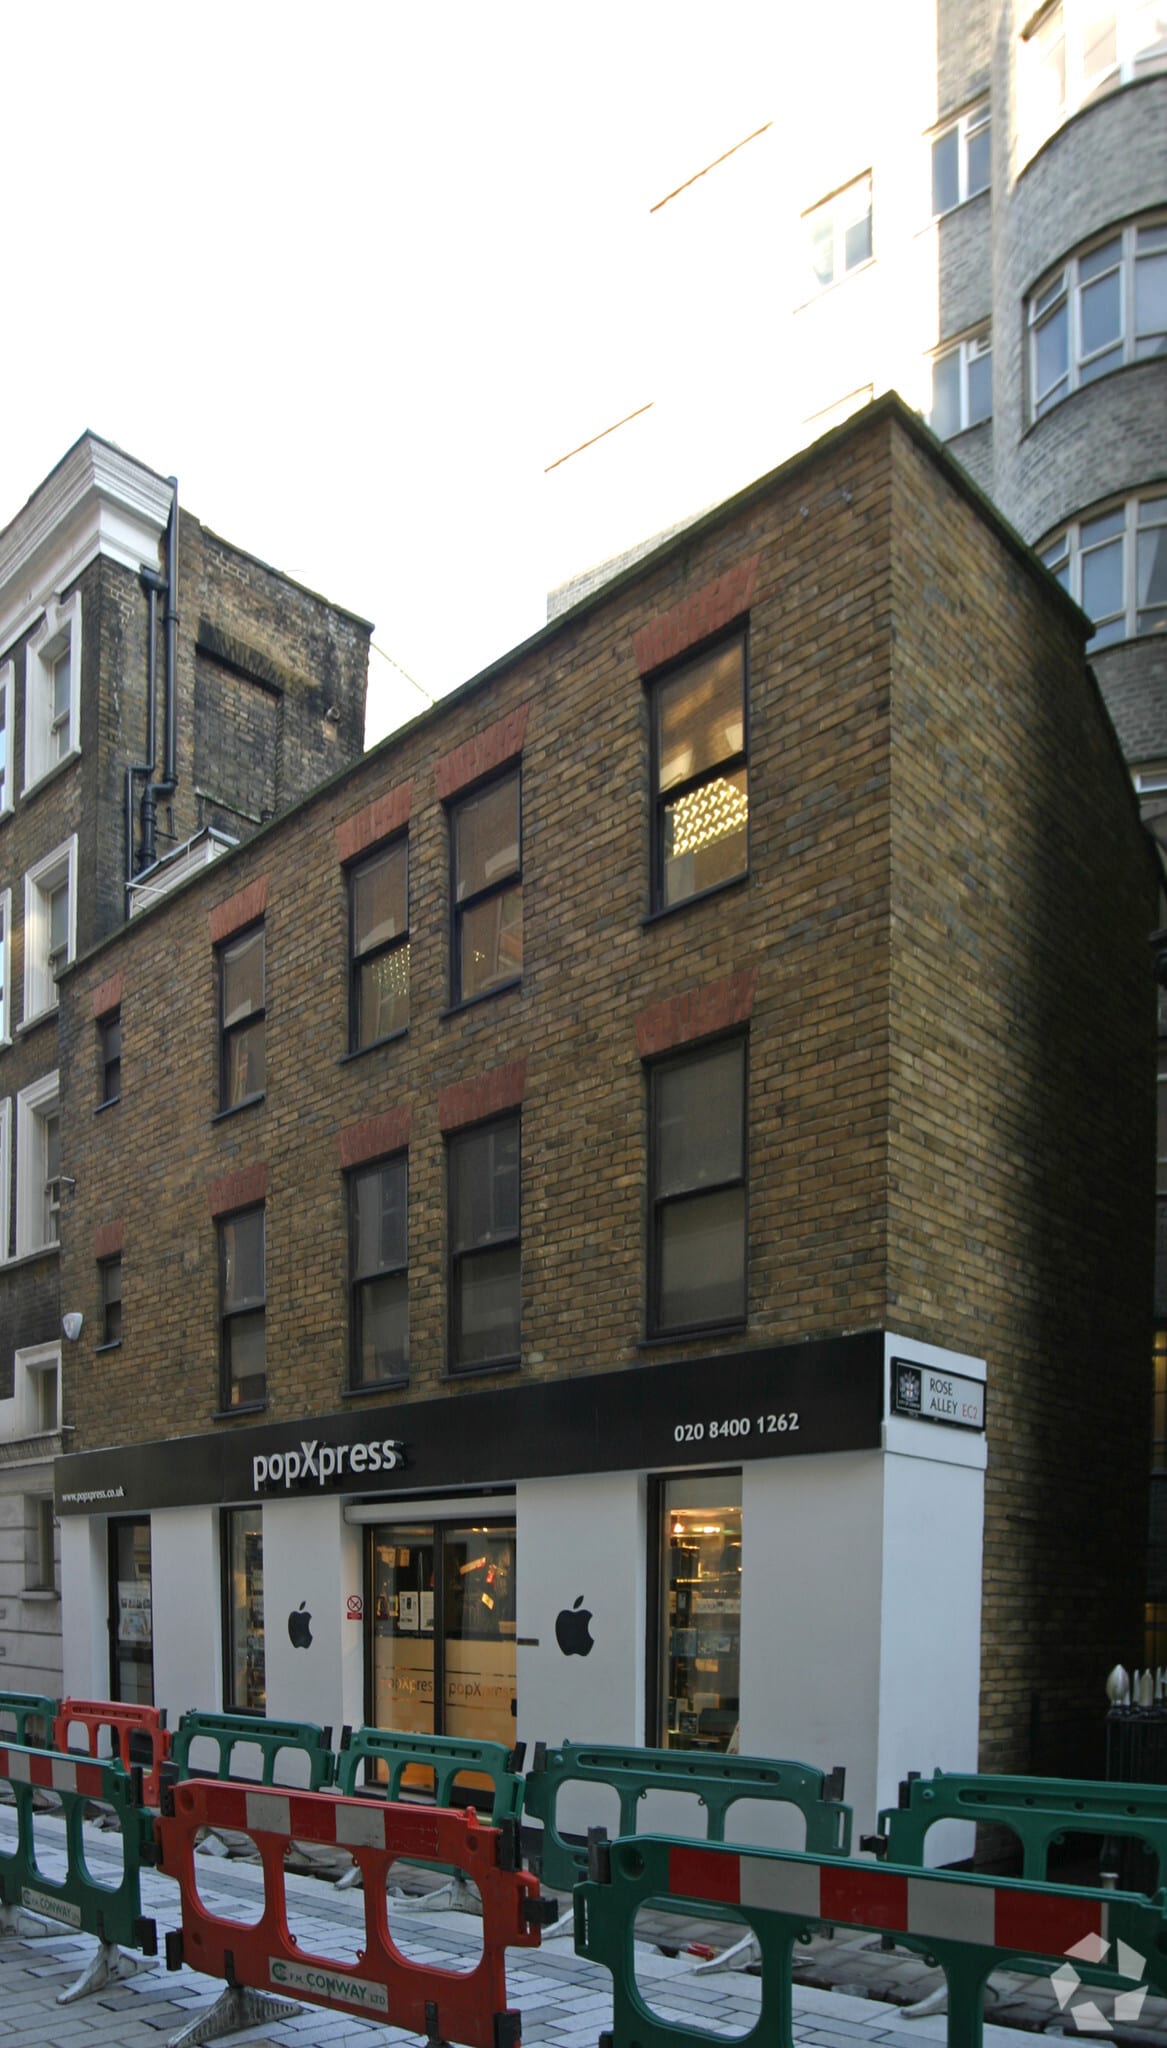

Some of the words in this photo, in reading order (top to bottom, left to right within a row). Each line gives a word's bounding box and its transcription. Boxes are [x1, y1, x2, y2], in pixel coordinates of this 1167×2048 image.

[929, 1377, 953, 1396] ROSE
[930, 1397, 958, 1415] ALLEY
[962, 1404, 978, 1419] EC2
[674, 1423, 704, 1442] 020
[709, 1418, 750, 1438] 8400
[757, 1412, 799, 1434] 1262
[253, 1440, 397, 1492] popXpress
[62, 1486, 124, 1503] www.popxpress.co.uk
[306, 1973, 367, 2000] CONWAY
[370, 1994, 386, 2005] LTD
